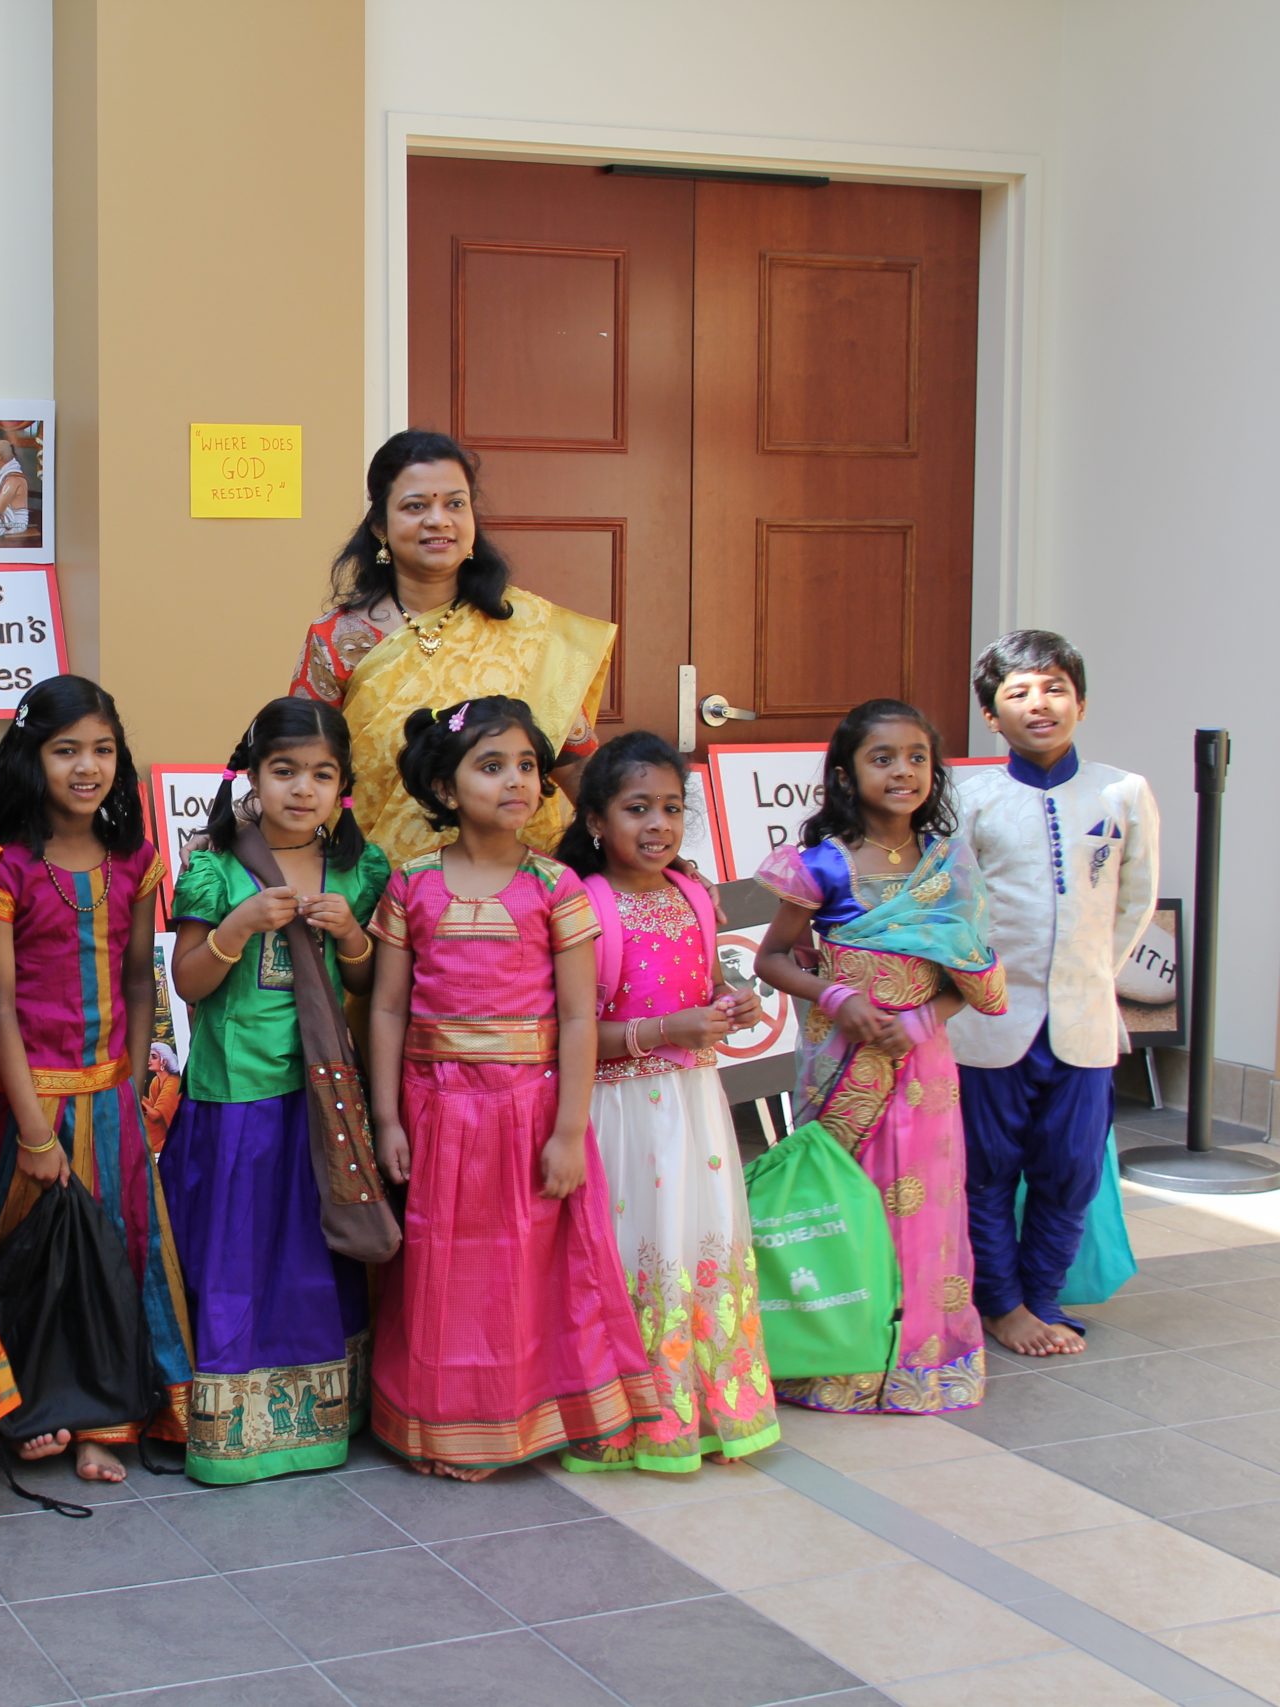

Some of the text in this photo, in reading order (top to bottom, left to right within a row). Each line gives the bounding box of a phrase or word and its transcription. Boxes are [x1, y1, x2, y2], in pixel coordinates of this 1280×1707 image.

[259, 437, 294, 451] DOES
[221, 456, 266, 480] GOD
[170, 785, 216, 817] Lov
[1129, 944, 1177, 984] ITH
[752, 1218, 848, 1248] OOD HEALTH
